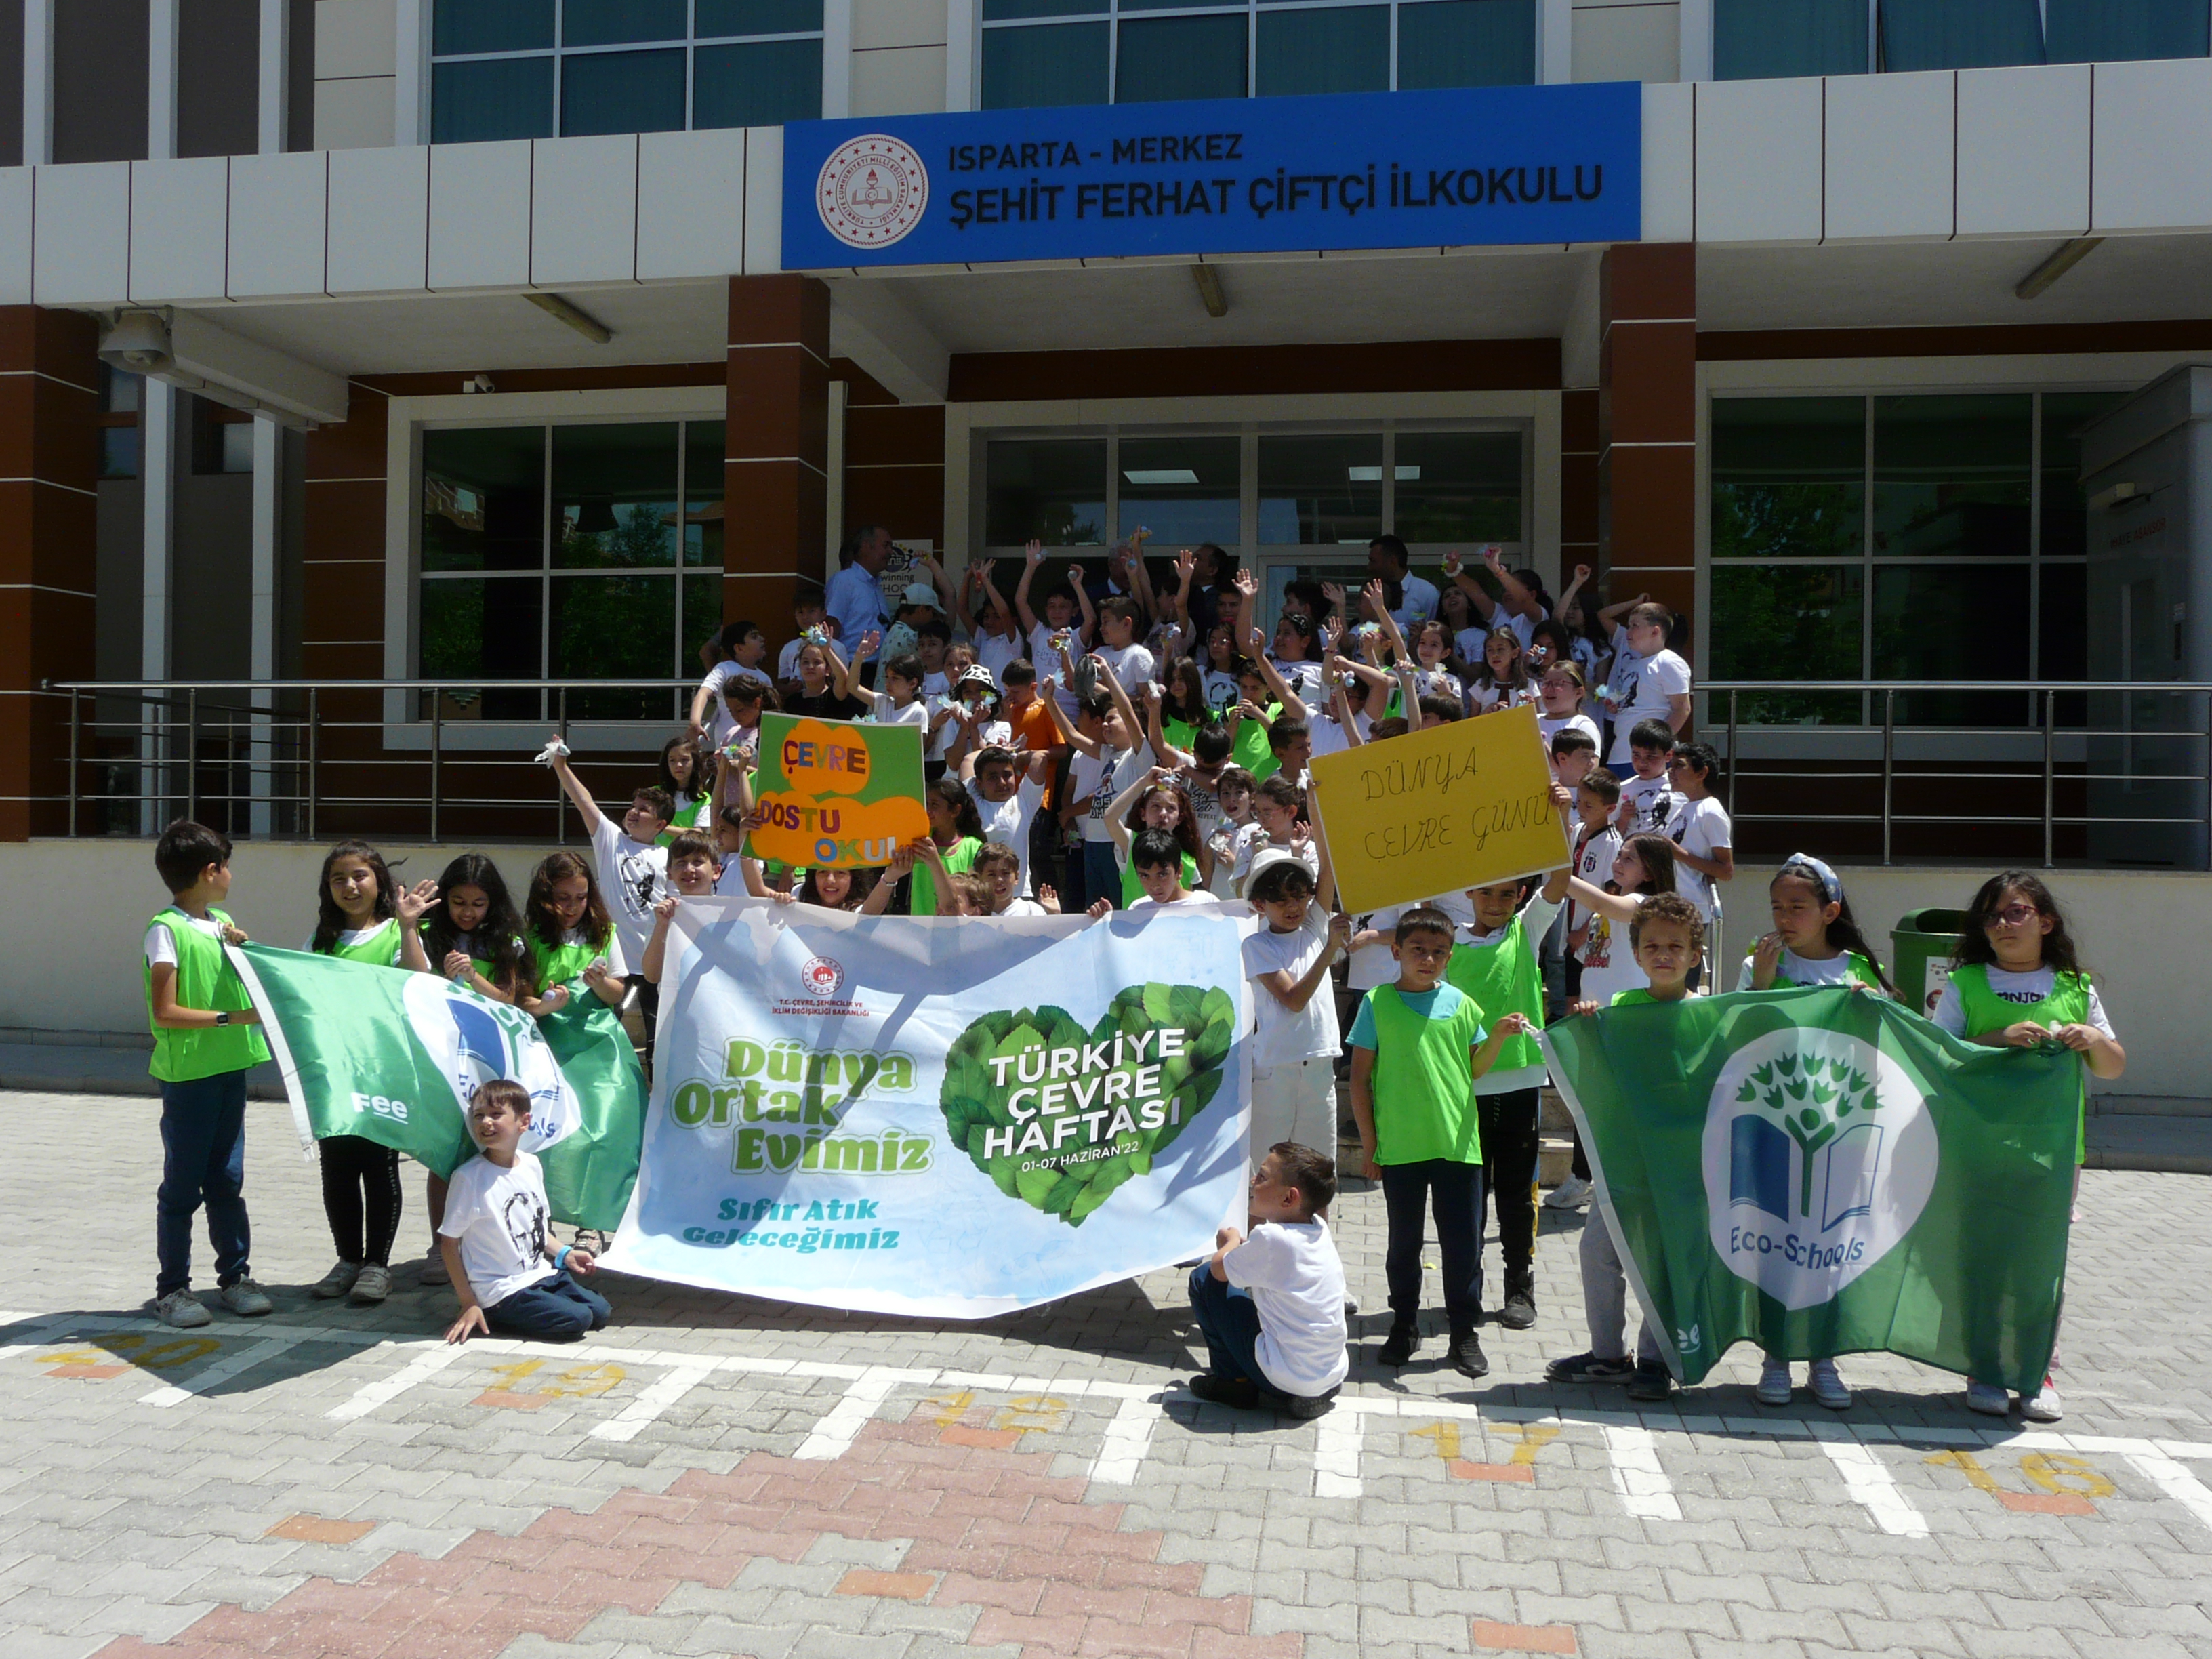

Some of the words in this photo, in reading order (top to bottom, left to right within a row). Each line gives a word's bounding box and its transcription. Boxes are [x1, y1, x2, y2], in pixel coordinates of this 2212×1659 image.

[949, 142, 1081, 171] ISPARTA
[1112, 134, 1242, 165] MERKEZ
[949, 178, 1064, 230] ŞEHİT
[1076, 179, 1237, 219] FERHAT
[1248, 163, 1375, 220] ÇİFTÇİ
[1390, 163, 1603, 207] İLKOKULU
[880, 573, 915, 583] winning
[783, 740, 867, 775] ÇEVRE
[1361, 746, 1479, 802] DÜNYA
[760, 800, 841, 834] DOSTU
[1364, 815, 1452, 863] ÇEVRE
[1471, 792, 1550, 851] GÜNÜ
[771, 1006, 791, 1015] İKLİM
[816, 999, 853, 1008] ŞEHİRCİLİK
[726, 1040, 913, 1097] Dünya
[988, 1028, 1185, 1087] TÜRKİYE
[674, 1079, 842, 1126] Ortak
[1007, 1063, 1162, 1126] ÇEVRE
[735, 1128, 932, 1172] Evimiz
[983, 1097, 1181, 1160] HAFTASI
[1021, 1157, 1057, 1172] 01-07
[717, 1197, 800, 1221] Sıfır
[802, 1197, 880, 1221] Atık
[682, 1226, 900, 1254] Geleceğimiz
[1730, 1225, 1865, 1270] Eco-Schools
[1407, 1422, 1561, 1465] 17
[1923, 1450, 2117, 1498] 16
